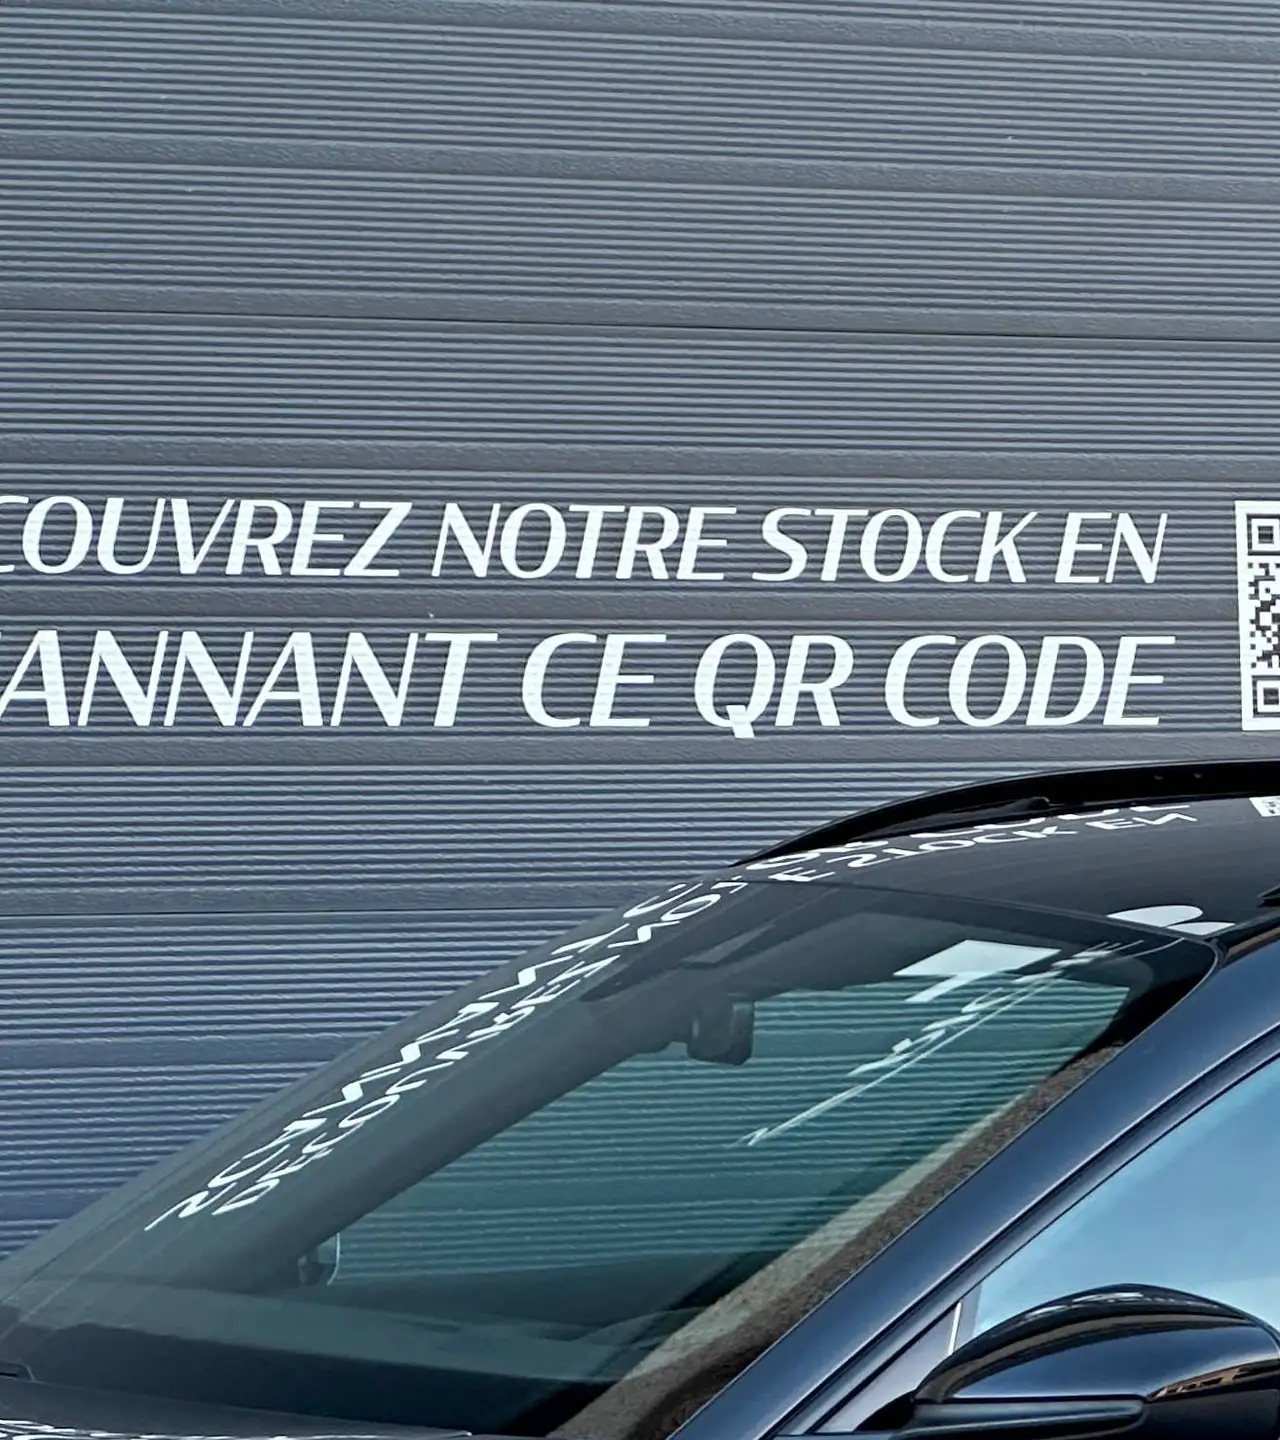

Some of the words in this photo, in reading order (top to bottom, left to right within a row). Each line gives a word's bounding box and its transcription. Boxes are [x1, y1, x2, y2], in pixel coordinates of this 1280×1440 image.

[432, 503, 737, 580] NOTRE
[752, 508, 1038, 583] STOCK
[1055, 512, 1168, 584] EN
[0, 630, 498, 727] ANNANT
[522, 633, 667, 728] CE
[694, 634, 854, 739] QR
[884, 634, 1176, 727] CODE
